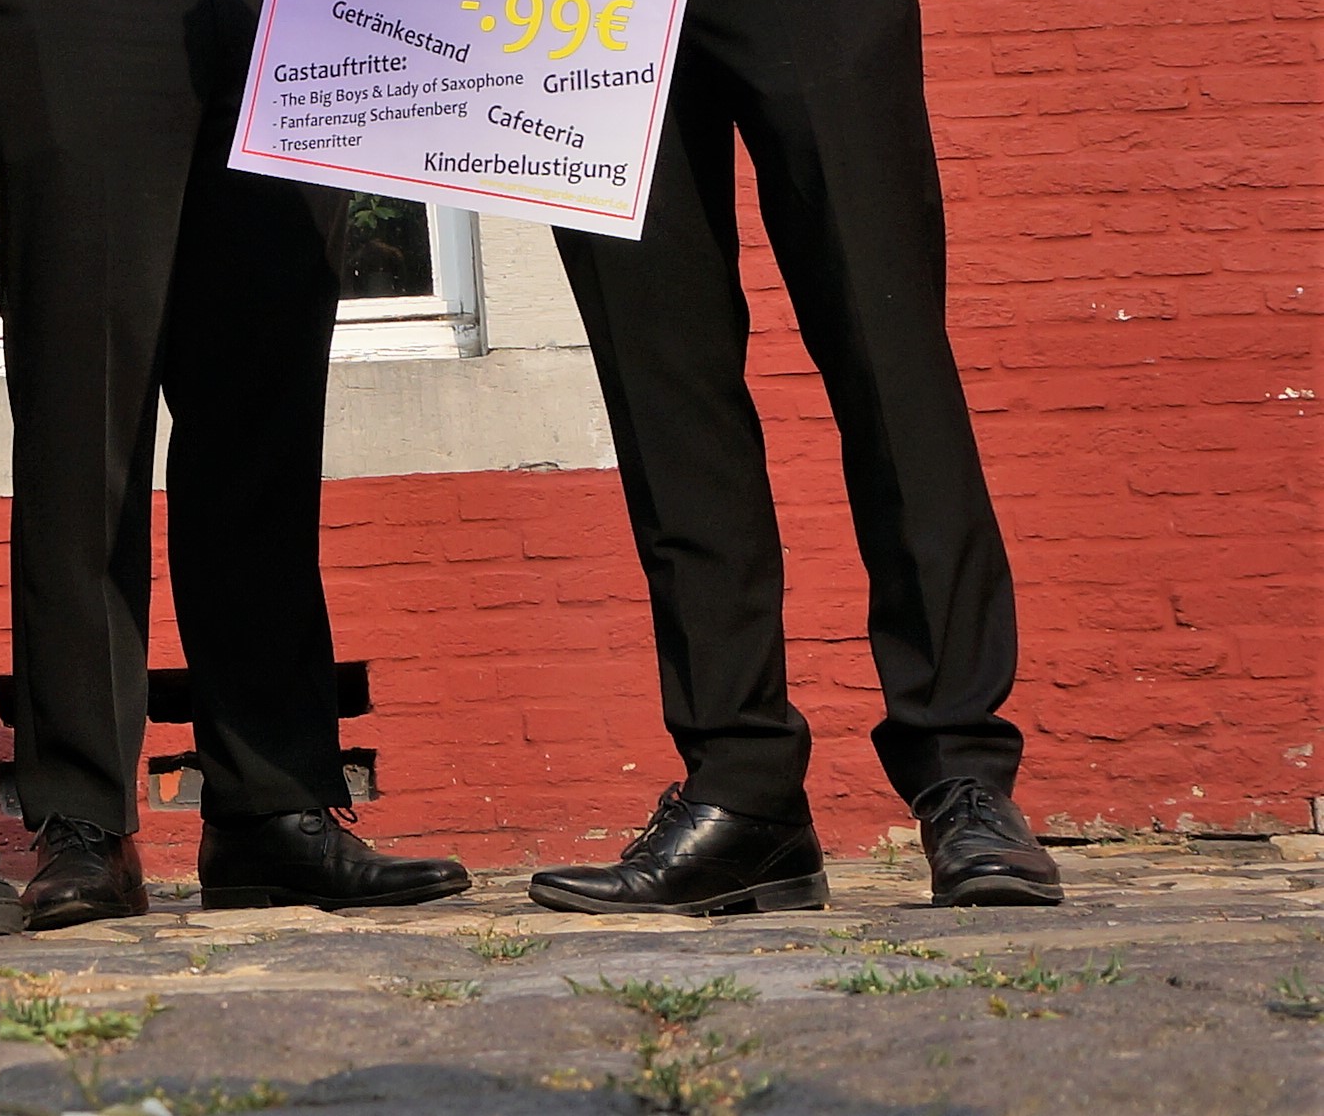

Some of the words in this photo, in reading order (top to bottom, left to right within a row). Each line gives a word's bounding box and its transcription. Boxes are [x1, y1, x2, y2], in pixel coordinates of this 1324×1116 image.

[333, 1, 470, 63] Getränkestand
[274, 55, 406, 82] Gastauftritte:
[544, 63, 654, 93] Grillstand
[280, 93, 306, 107] The
[310, 90, 332, 107] Big
[336, 89, 368, 104] Boys
[372, 85, 382, 98] &
[387, 81, 419, 98] Lady
[423, 78, 437, 93] of
[441, 73, 523, 92] Saxophone
[281, 111, 366, 129] Fanfarenzug
[370, 101, 468, 121] Schaufenberg
[488, 105, 584, 148] Cafeteria
[280, 134, 362, 151] Tresenritter
[425, 152, 628, 186] Kinderbelustigung
